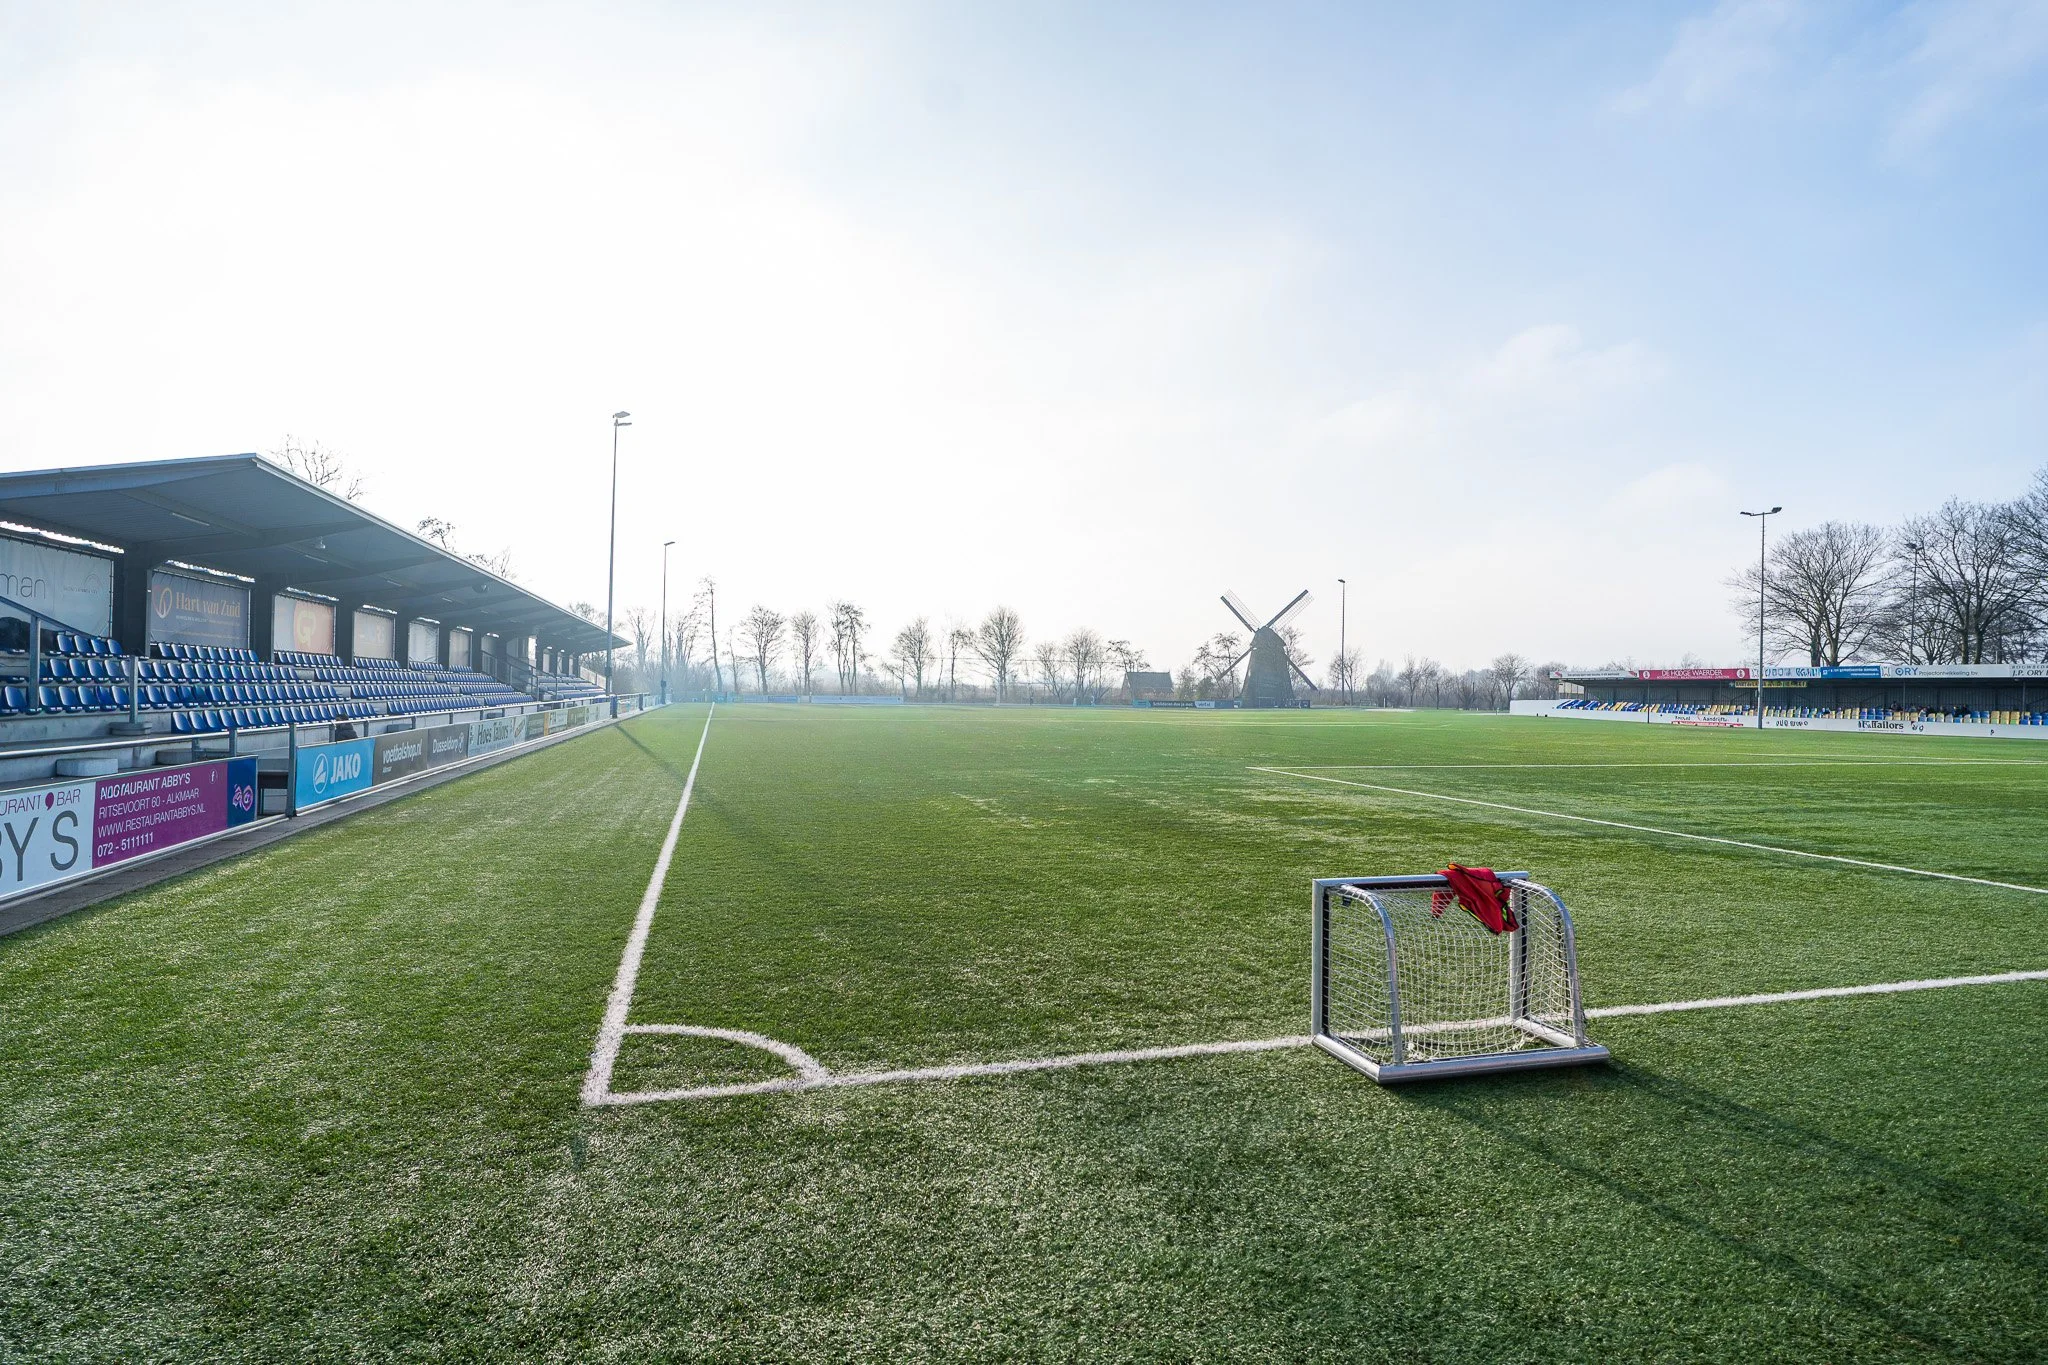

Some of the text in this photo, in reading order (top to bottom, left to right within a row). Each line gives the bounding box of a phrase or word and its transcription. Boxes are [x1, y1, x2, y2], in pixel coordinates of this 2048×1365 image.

[176, 592, 240, 617] Hart van Zuid
[1895, 667, 1918, 676] ORY
[161, 772, 191, 789] ABBY'S
[330, 753, 361, 784] JAKO
[57, 788, 81, 807] BAR
[98, 797, 149, 819] RITSEVOORT
[151, 796, 161, 808] 60
[166, 788, 200, 804] ALKMAAR
[97, 804, 206, 838] WWW.RESTAURANTABBYS.NL
[0, 810, 79, 882] YS
[97, 842, 114, 858] 072
[121, 832, 154, 851] 5111111
